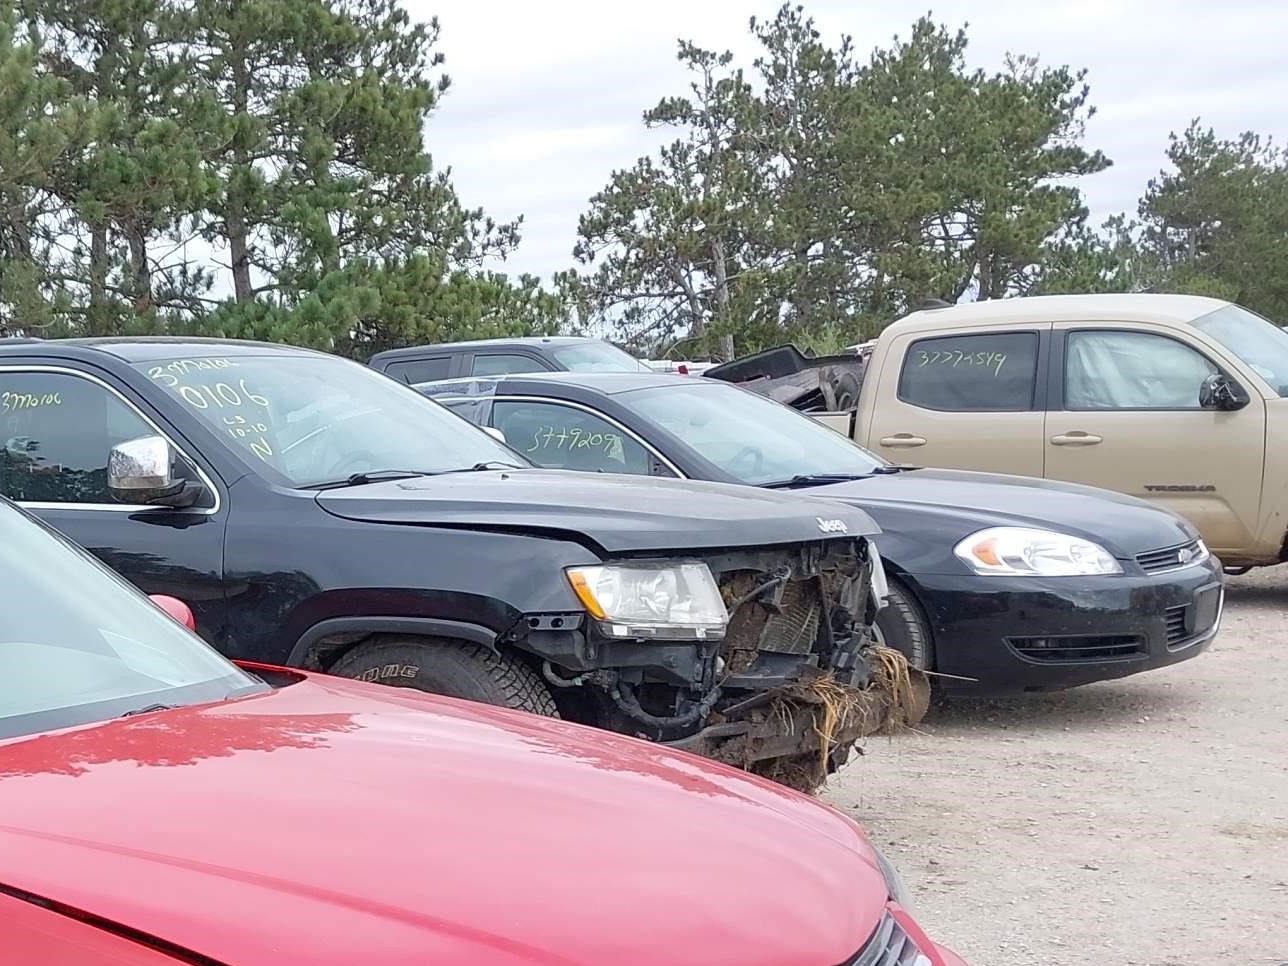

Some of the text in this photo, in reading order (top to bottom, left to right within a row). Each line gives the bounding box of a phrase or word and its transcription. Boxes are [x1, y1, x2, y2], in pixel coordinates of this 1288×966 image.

[180, 379, 268, 408] 0106
[250, 436, 273, 461] N
[815, 517, 848, 534] Jeep
